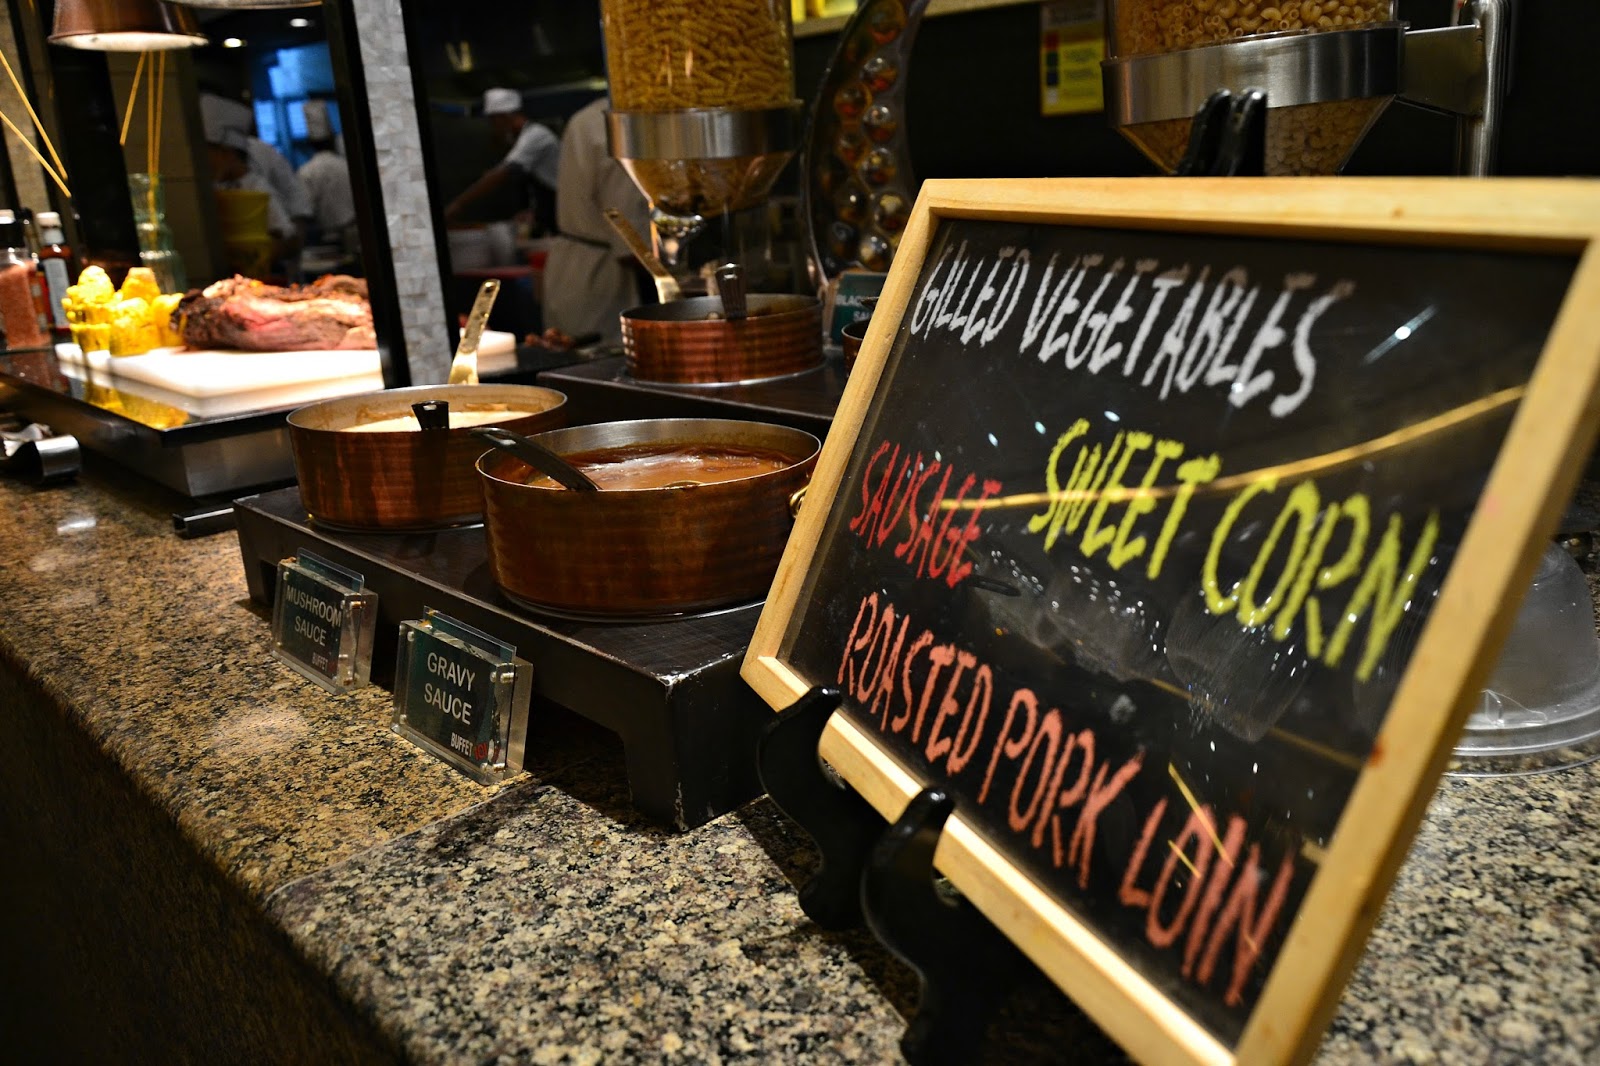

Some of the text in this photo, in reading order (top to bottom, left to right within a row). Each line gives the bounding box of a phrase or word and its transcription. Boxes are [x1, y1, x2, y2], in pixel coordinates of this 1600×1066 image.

[1019, 252, 1355, 417] VEGETABLES
[850, 440, 1002, 583] SAUSAGE
[1028, 418, 1439, 683] SWEET CORN
[286, 585, 342, 628] MUSHROOM
[294, 615, 327, 647] SAUCE
[427, 651, 475, 692] GRAVY
[424, 682, 472, 725] SAUCE
[450, 731, 474, 757] BUFFET
[837, 591, 1295, 1006] ROASTED PORK LOIN
